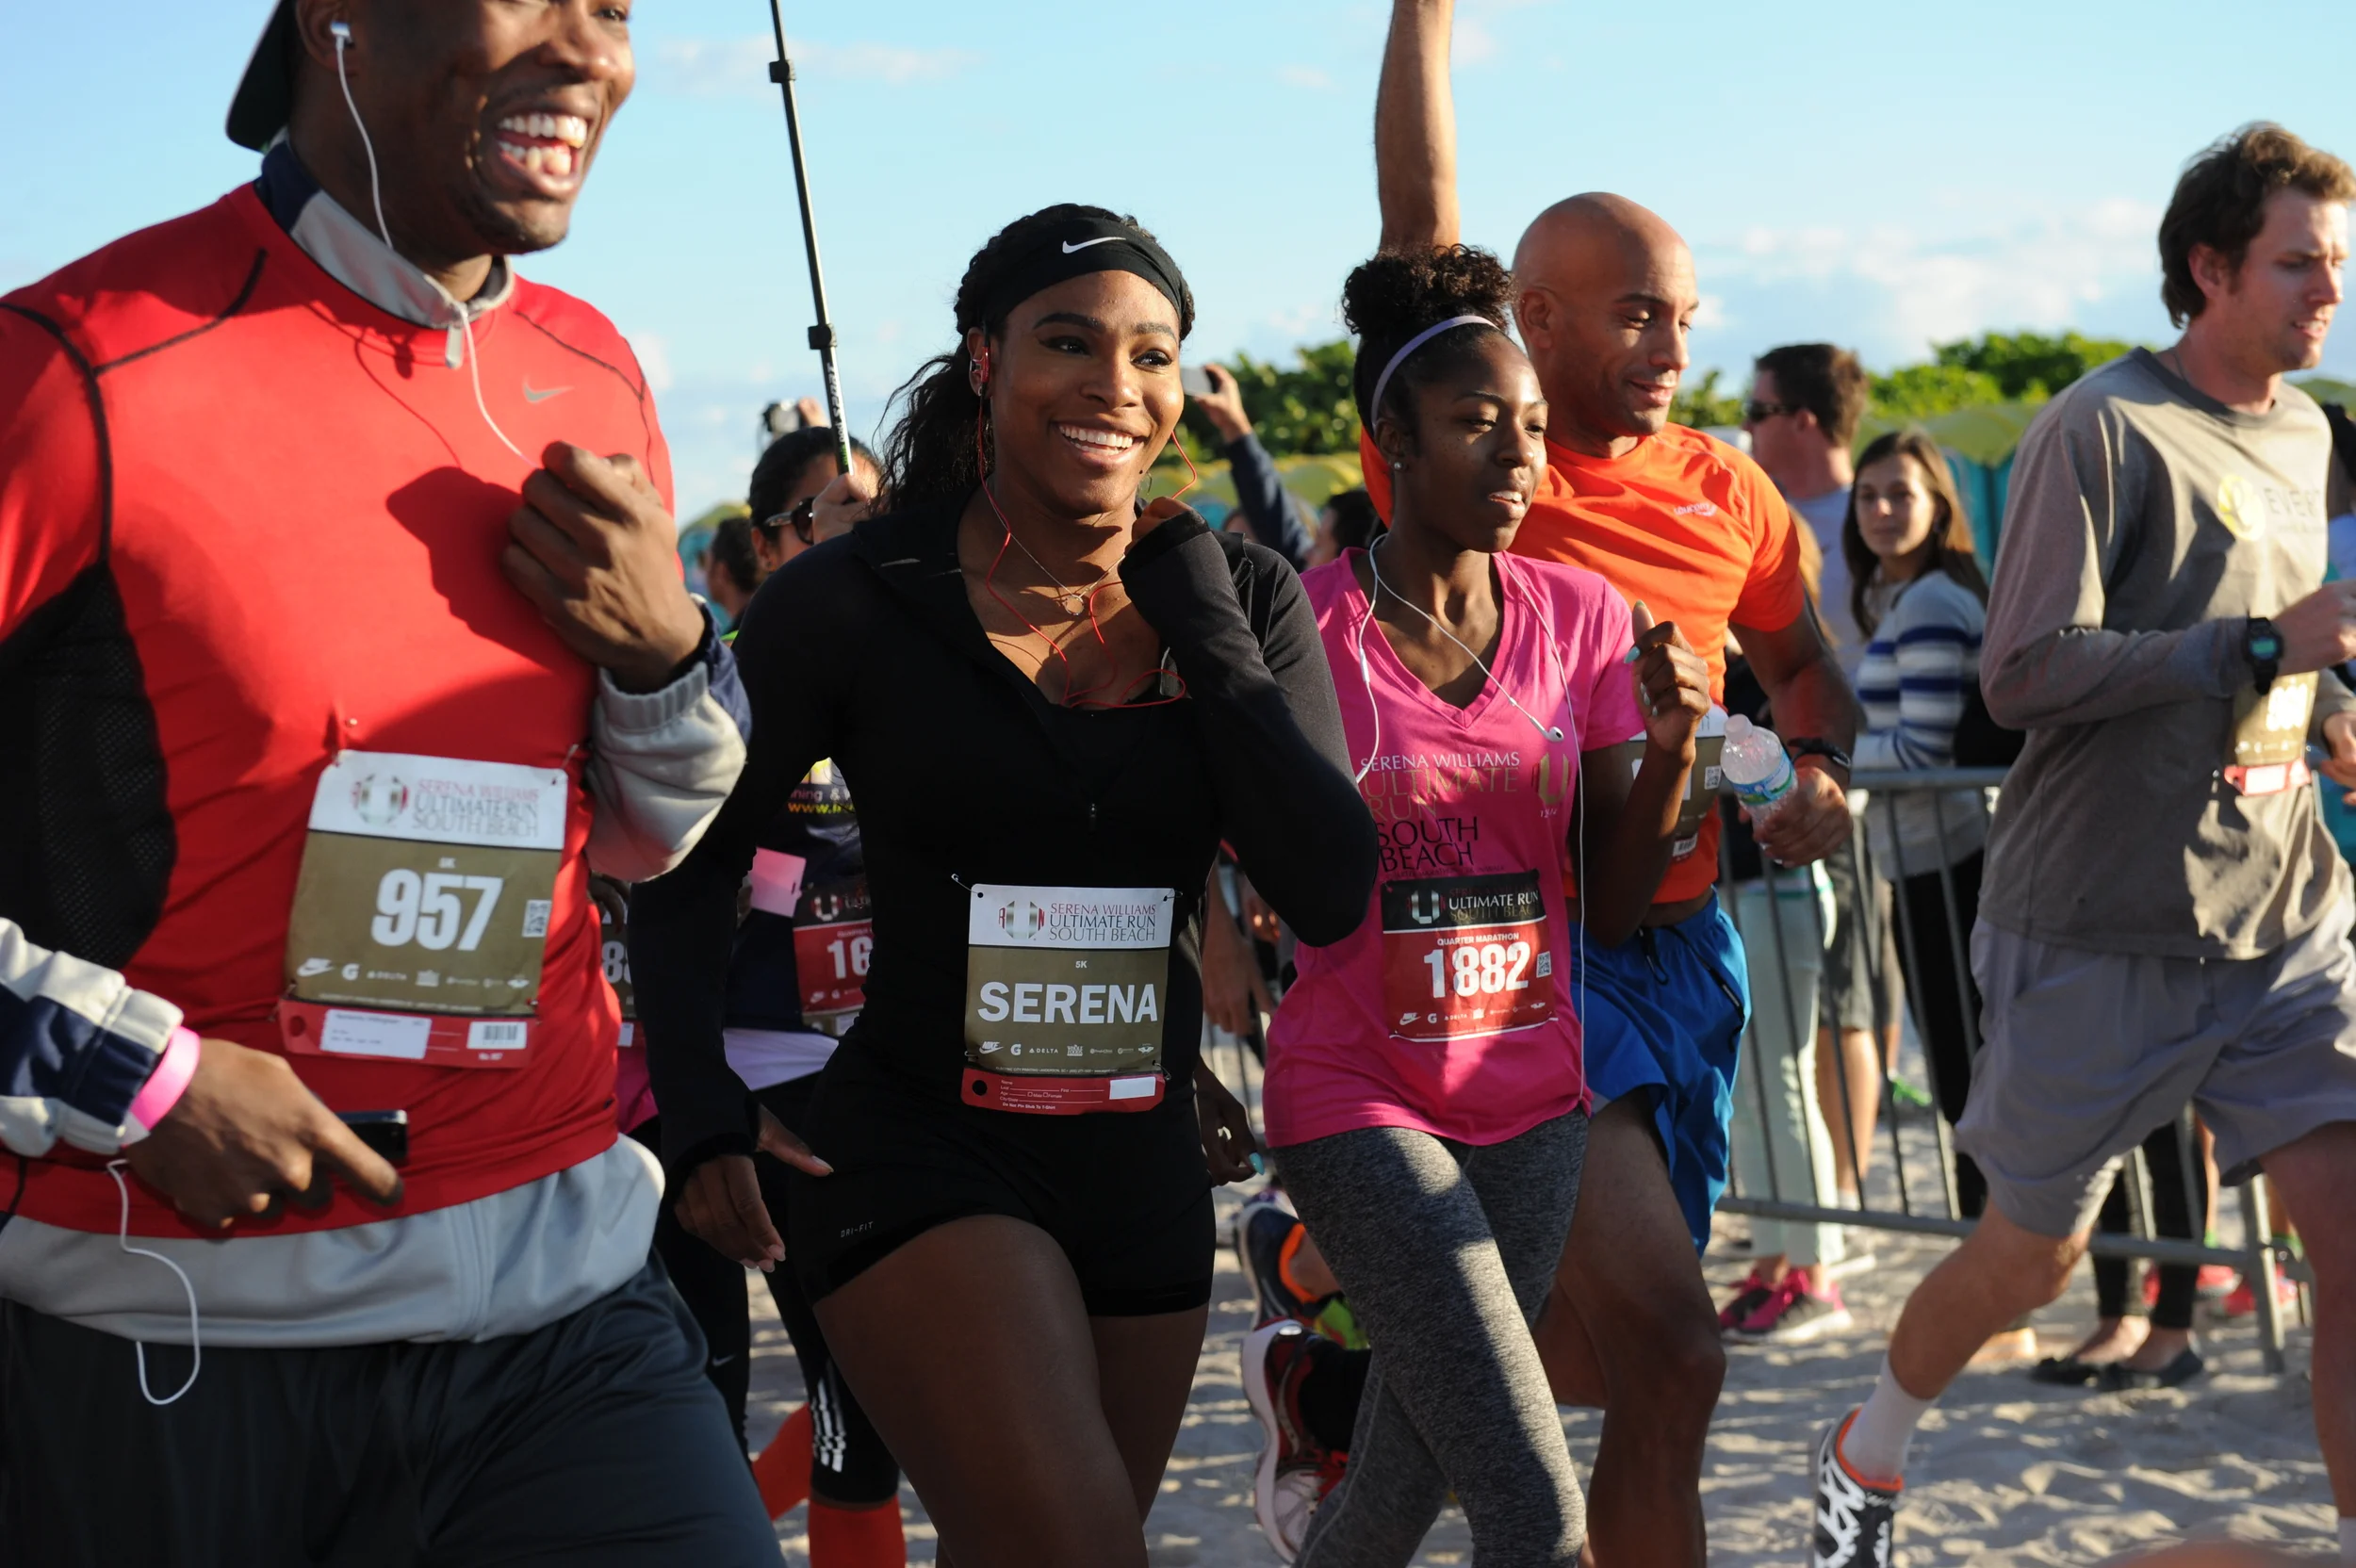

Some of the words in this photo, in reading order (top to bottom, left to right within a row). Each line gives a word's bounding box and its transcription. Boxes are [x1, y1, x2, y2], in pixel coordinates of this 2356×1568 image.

[1360, 755, 1429, 772] SERENA
[1432, 752, 1520, 768] WILLIAMS
[418, 778, 475, 796] SERENA
[1364, 767, 1519, 798] ULTIMATE
[414, 794, 500, 818] ULTIMATE
[1366, 793, 1437, 822] RUN
[412, 812, 481, 834] SOUTH
[486, 816, 538, 837] BEACH
[1378, 816, 1479, 847] SOUTH
[1379, 841, 1475, 873] BEACH
[1051, 903, 1099, 915] SERENA
[1103, 904, 1156, 915] WILLIAMS
[1448, 893, 1513, 910] ULTIMATE
[1517, 890, 1539, 905] RUN
[370, 869, 504, 952] 957
[1449, 906, 1498, 921] SOUTH
[1050, 914, 1122, 928] ULTIMATE
[1127, 915, 1156, 928] RUN
[1049, 927, 1105, 941] SOUTH
[1110, 928, 1155, 941] BEACH
[1437, 935, 1474, 946] QUARTER
[1476, 933, 1519, 943] MARATHON
[1075, 960, 1088, 969] 5K
[1423, 941, 1530, 999] 1882
[977, 982, 1158, 1024] SERENA
[841, 1221, 874, 1237] DRI-FIT
